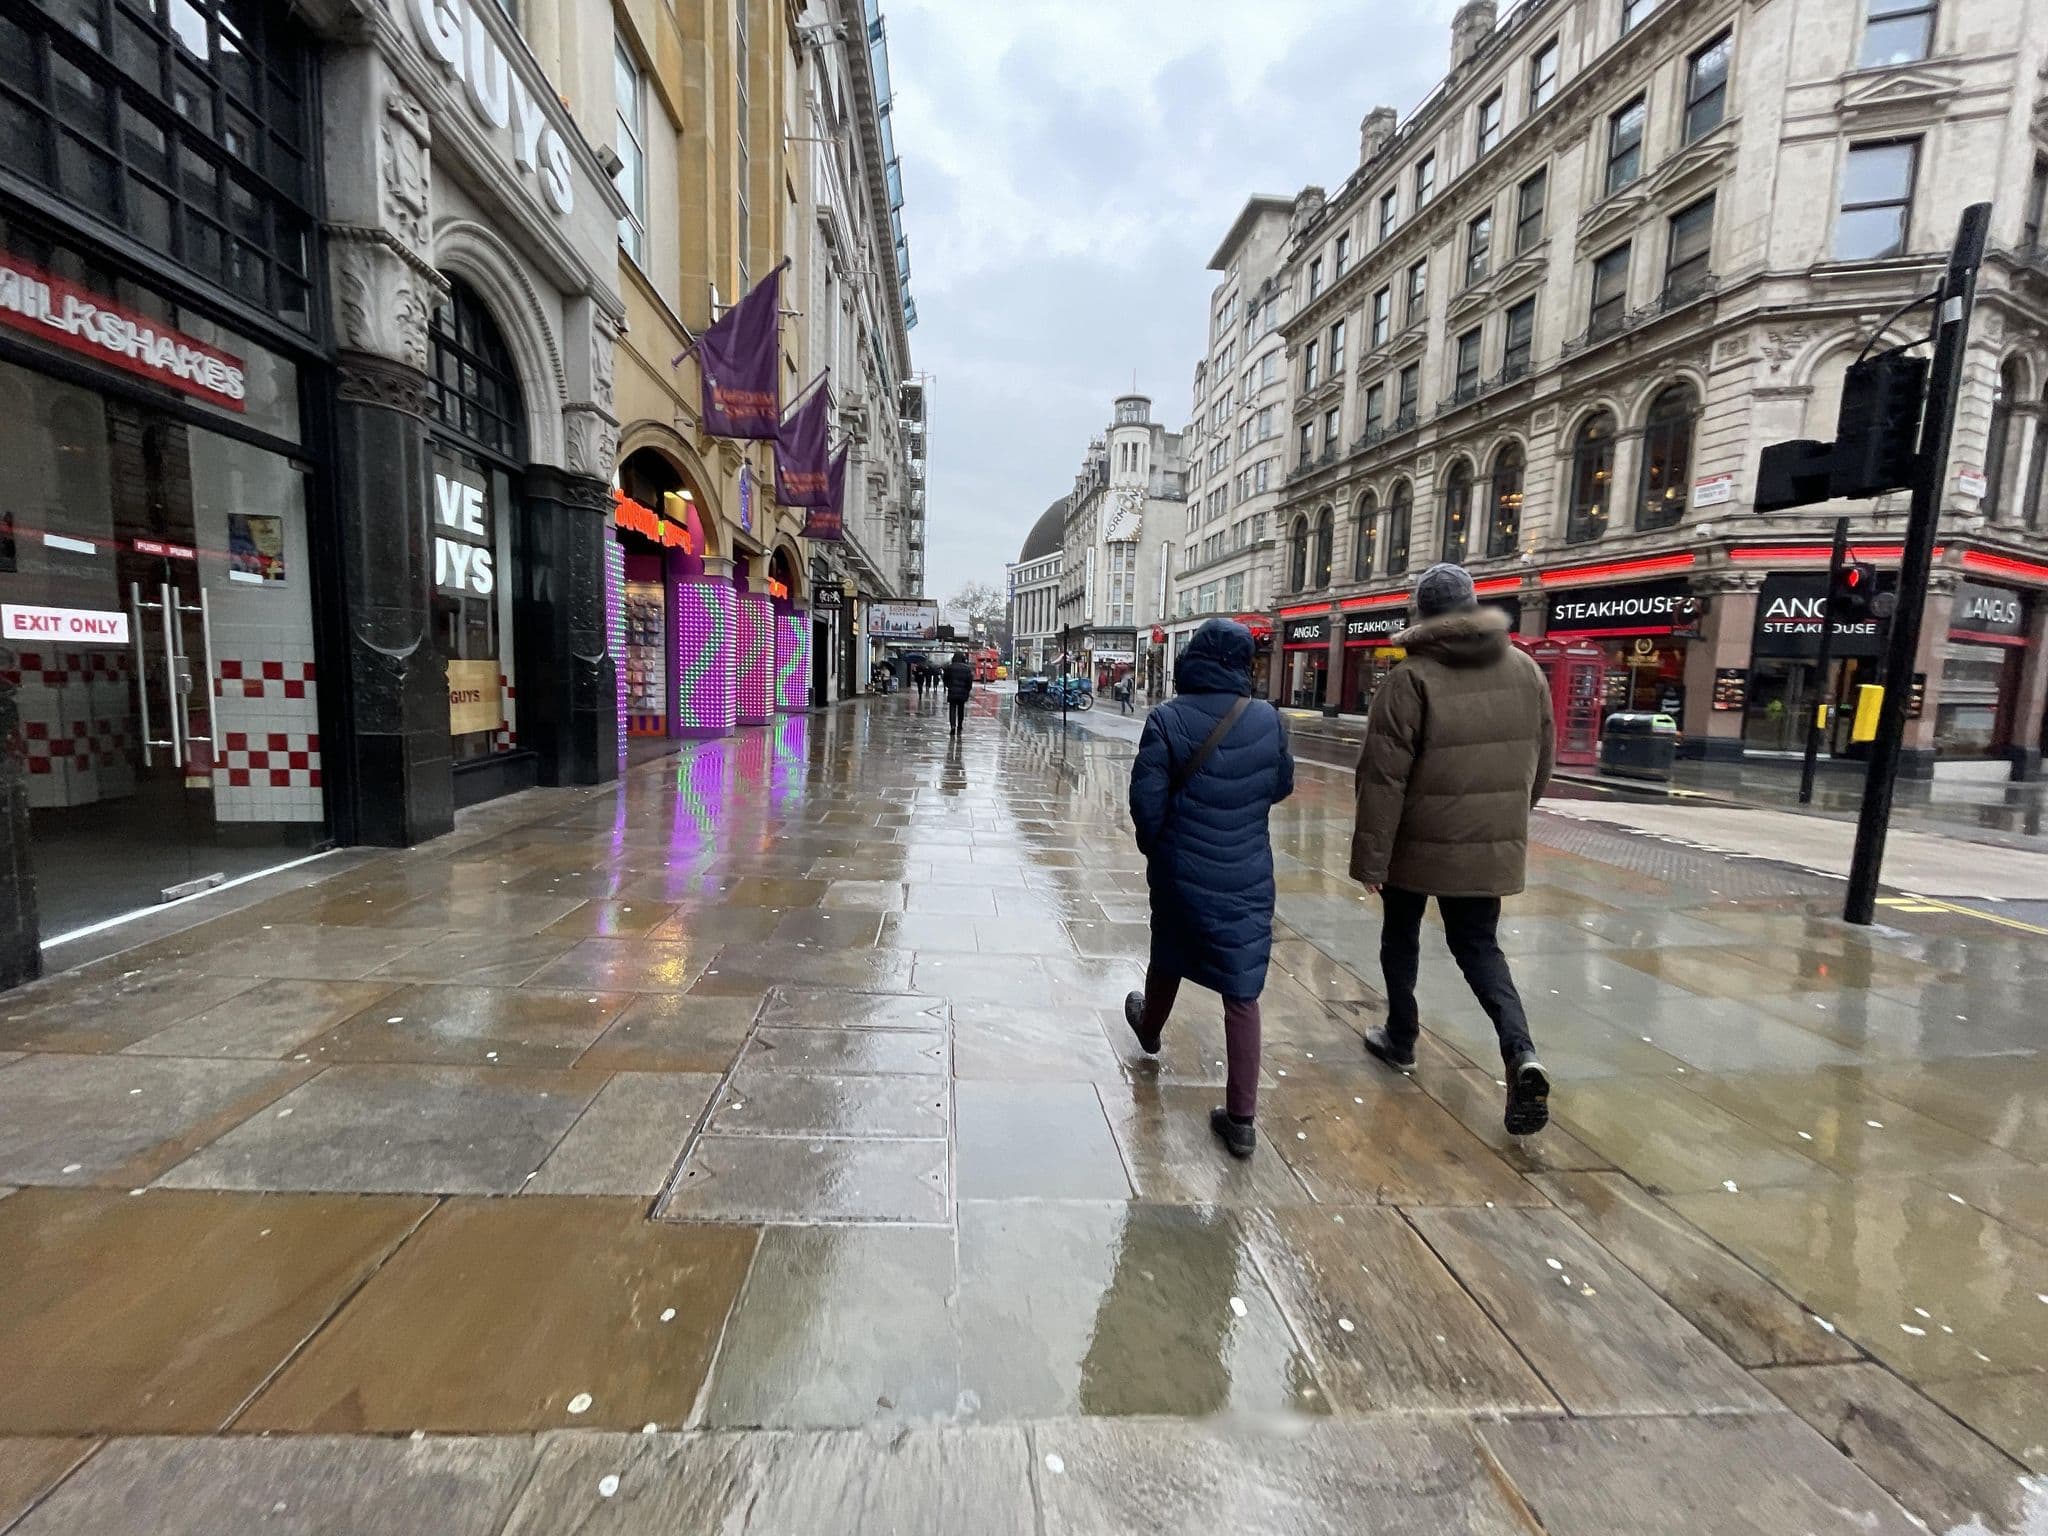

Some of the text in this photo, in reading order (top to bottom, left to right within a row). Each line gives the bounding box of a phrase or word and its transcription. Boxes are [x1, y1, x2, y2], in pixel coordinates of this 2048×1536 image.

[410, 0, 574, 215] GUYS
[434, 473, 485, 536] VE
[435, 537, 493, 594] YS
[13, 613, 118, 634] EXIT ONLY
[1293, 625, 1320, 639] ANGUS
[450, 689, 480, 704] GUYS
